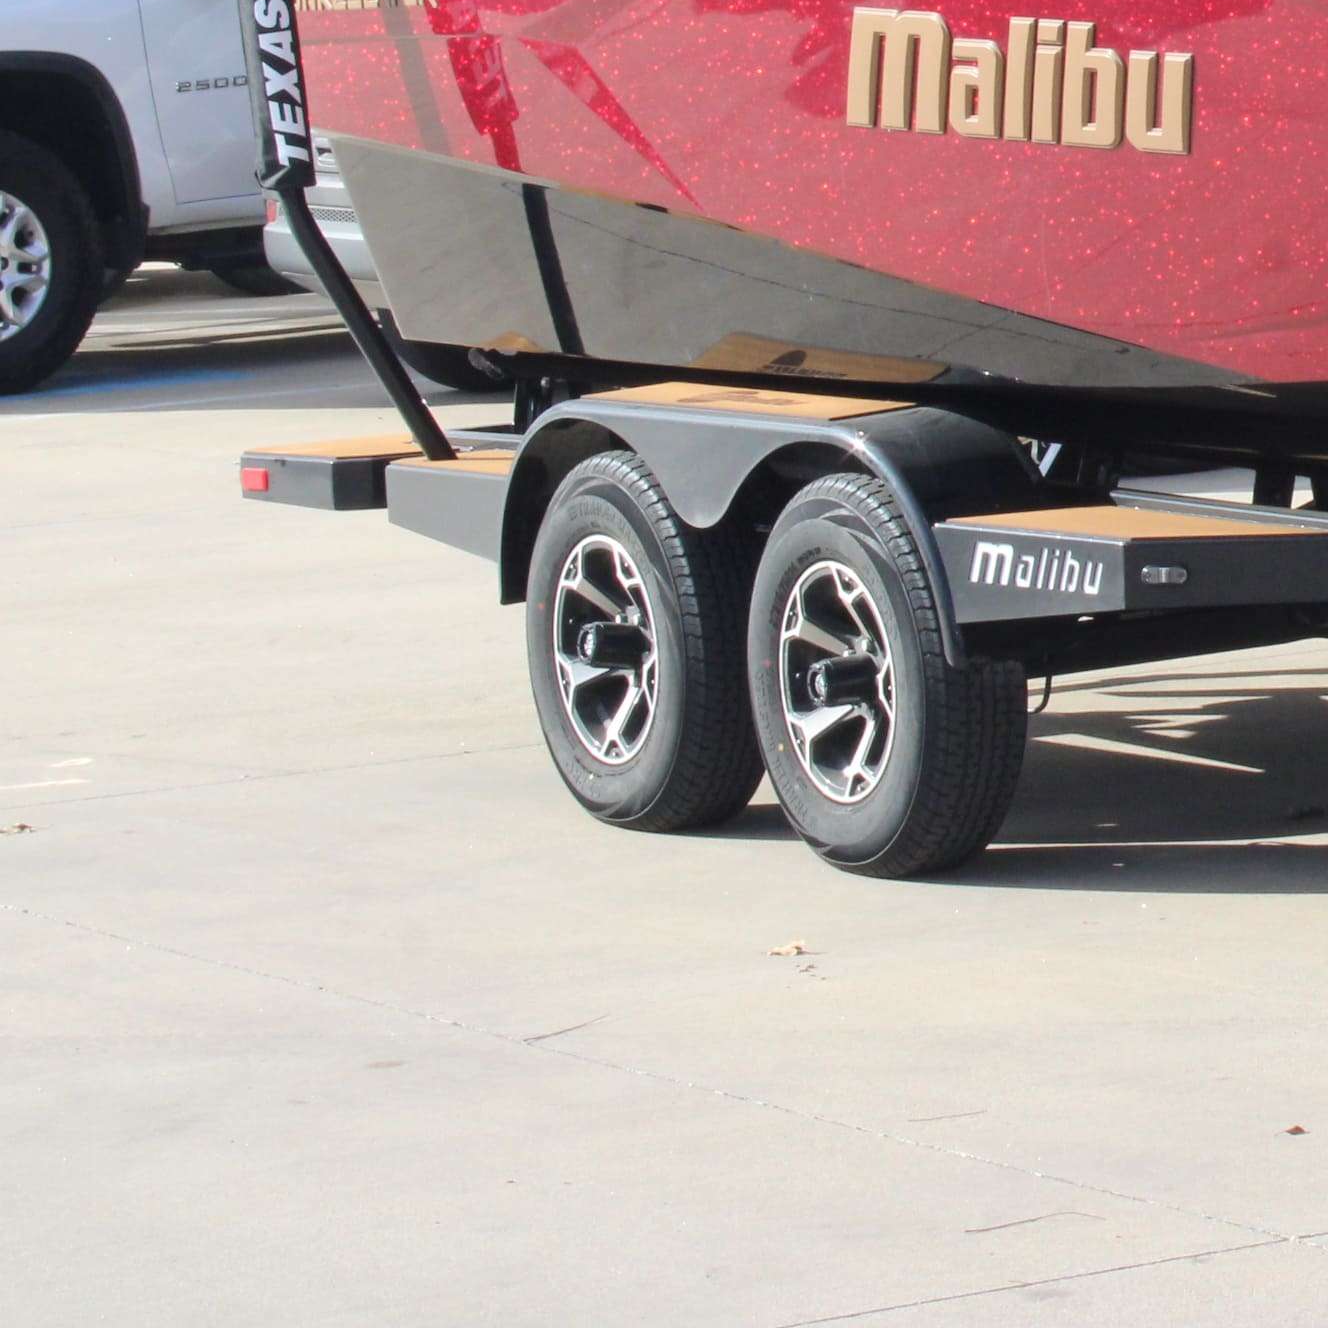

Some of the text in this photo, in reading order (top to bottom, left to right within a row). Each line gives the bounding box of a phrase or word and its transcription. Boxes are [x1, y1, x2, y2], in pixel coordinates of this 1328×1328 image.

[176, 75, 248, 93] 2500
[846, 5, 1195, 155] Malibu
[970, 541, 1103, 595] Malibu
